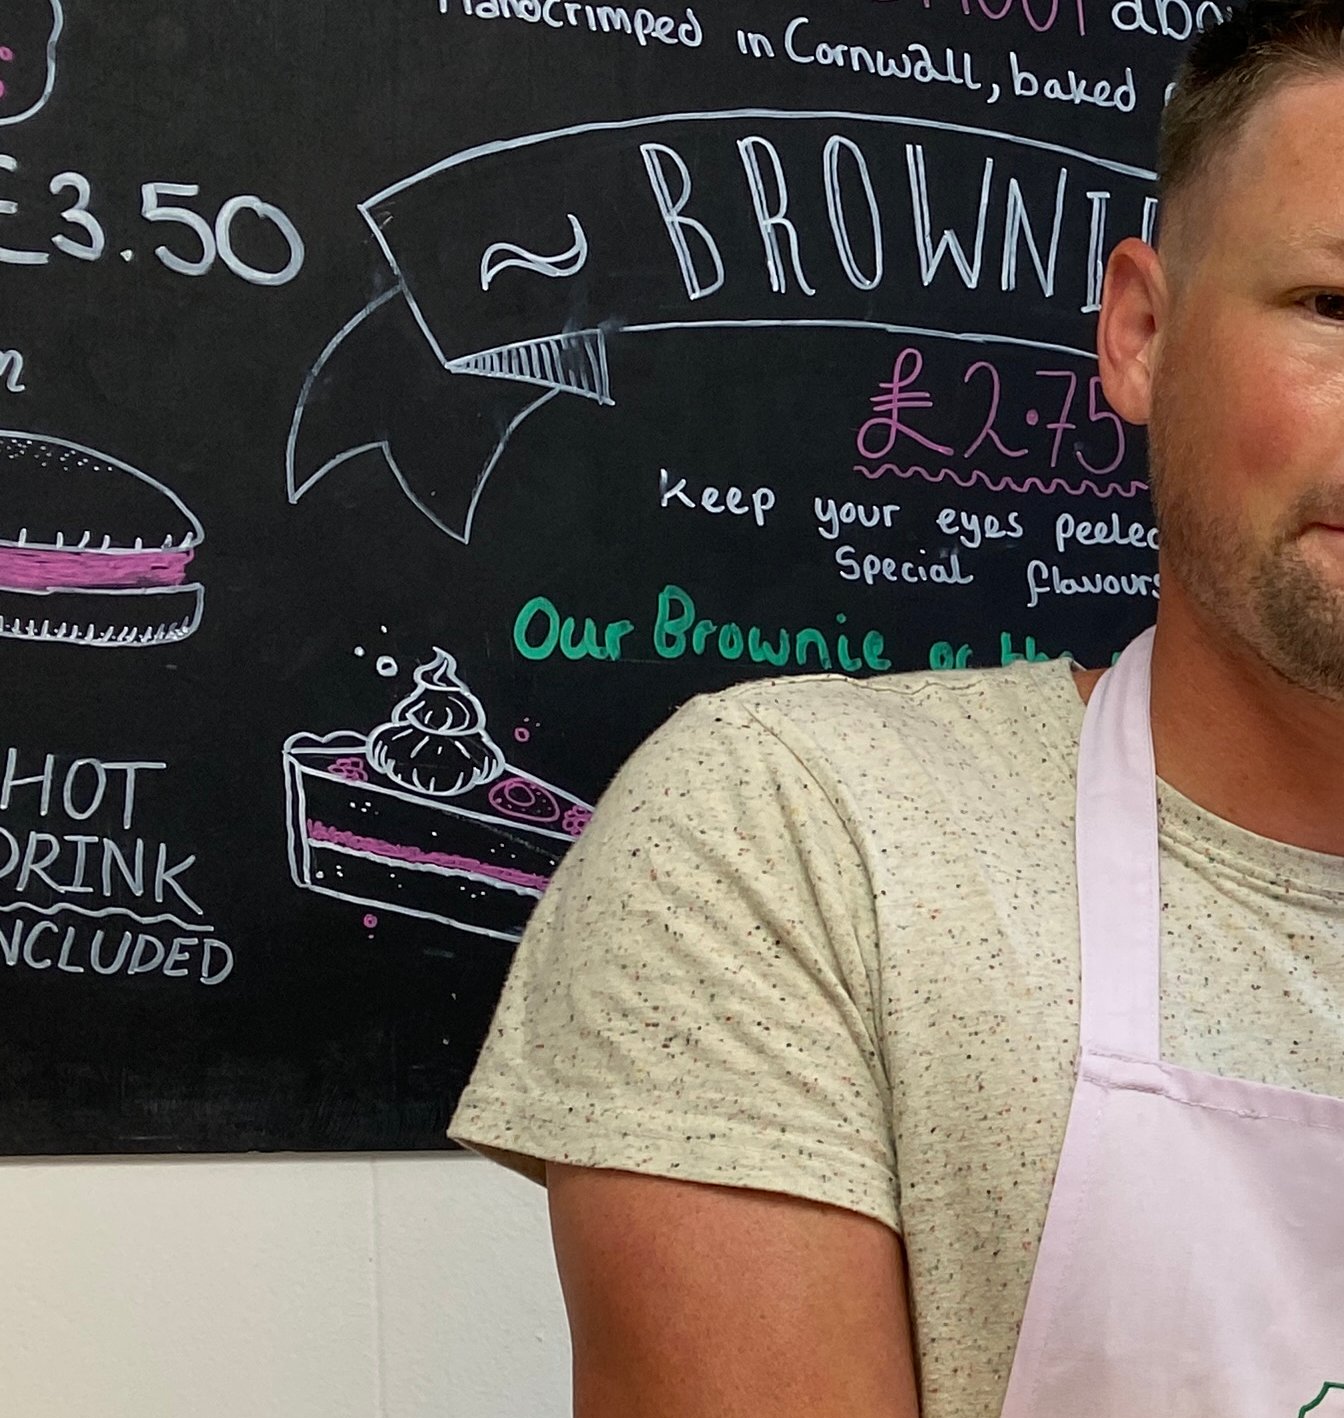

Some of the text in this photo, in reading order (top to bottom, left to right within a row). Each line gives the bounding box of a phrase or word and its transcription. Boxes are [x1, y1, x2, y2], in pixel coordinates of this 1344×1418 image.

[1111, 0, 1233, 40] abo
[737, 30, 775, 58] in
[784, 18, 1000, 104] Cornwall,
[1009, 51, 1136, 112] baked
[814, 499, 900, 540] your
[936, 508, 1023, 549] eyes
[835, 545, 974, 585] Special
[512, 596, 634, 662] Our
[653, 585, 893, 673] Brownie
[0, 748, 167, 829] HOT
[0, 918, 235, 986] NCLUDED
